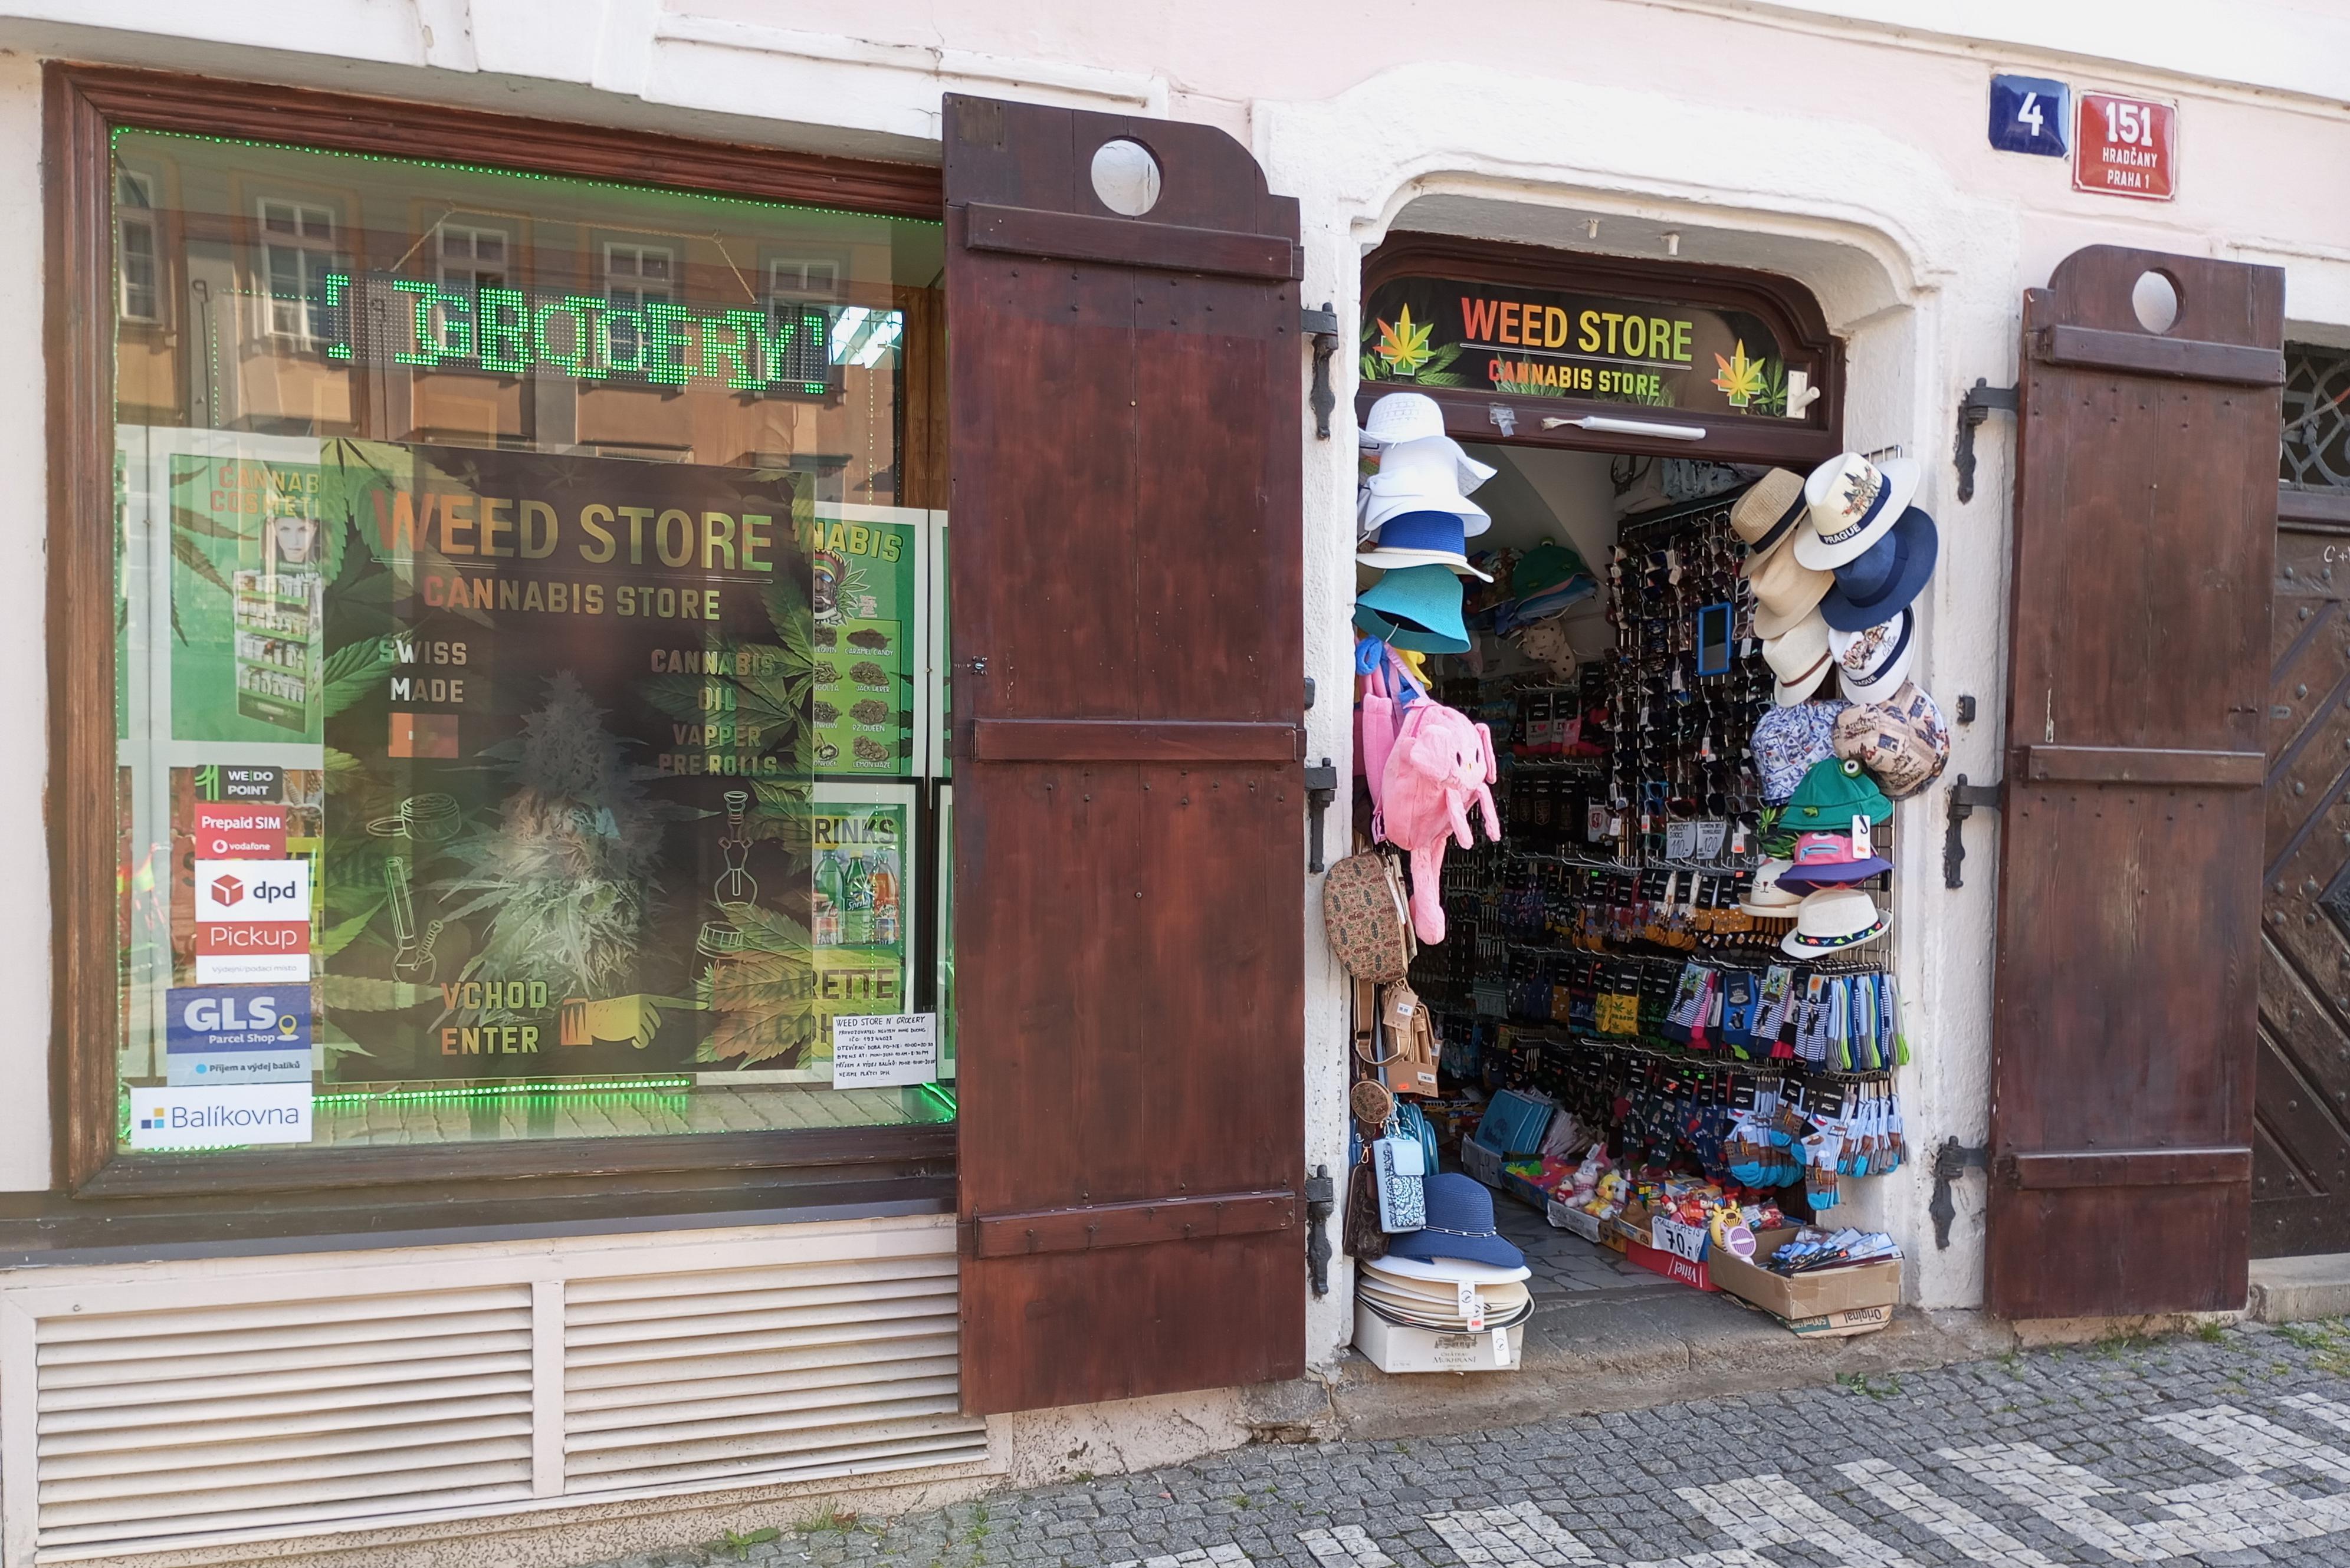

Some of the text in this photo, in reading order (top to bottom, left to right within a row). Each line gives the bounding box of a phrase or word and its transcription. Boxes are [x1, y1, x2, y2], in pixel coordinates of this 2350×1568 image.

[2018, 92, 2043, 136] 4
[2106, 102, 2152, 146] 151
[2103, 147, 2158, 168] HRADČANY
[2107, 170, 2149, 189] PRAHA 1
[1461, 297, 1692, 361] WEED STORE
[1488, 359, 1660, 396] CANNABIS STORE
[219, 466, 319, 494] CANNAB
[211, 490, 320, 518] COSMETI
[370, 489, 773, 573] WEED STORE
[1824, 523, 1862, 544] PRAGUE
[423, 576, 721, 620] CANNABIS STORE
[379, 639, 467, 666] SWISS
[651, 649, 776, 677] CANNABIS
[390, 678, 464, 703] MADE
[698, 687, 737, 712] OIL
[672, 724, 761, 748] VAPPER
[658, 753, 777, 777] PRE ROLLS
[228, 785, 269, 795] POINT
[202, 816, 281, 831] Prepaid SIM
[815, 818, 894, 844] RINKS
[229, 841, 271, 851] vodafone
[253, 881, 296, 903] dpd
[211, 926, 297, 949] Pickup
[441, 980, 547, 1010] VCHOD
[184, 996, 277, 1032] GLS
[209, 1034, 275, 1044] Parcel Shop
[441, 1026, 539, 1055] ENTER
[209, 1063, 238, 1073] Příjem
[247, 1062, 271, 1072] výdej
[273, 1061, 300, 1069] balíků
[172, 1106, 298, 1128] Balíkovna
[1654, 1217, 1670, 1228] SMALL
[1674, 1261, 1696, 1283] Vittel
[1843, 1309, 1882, 1324] Original
